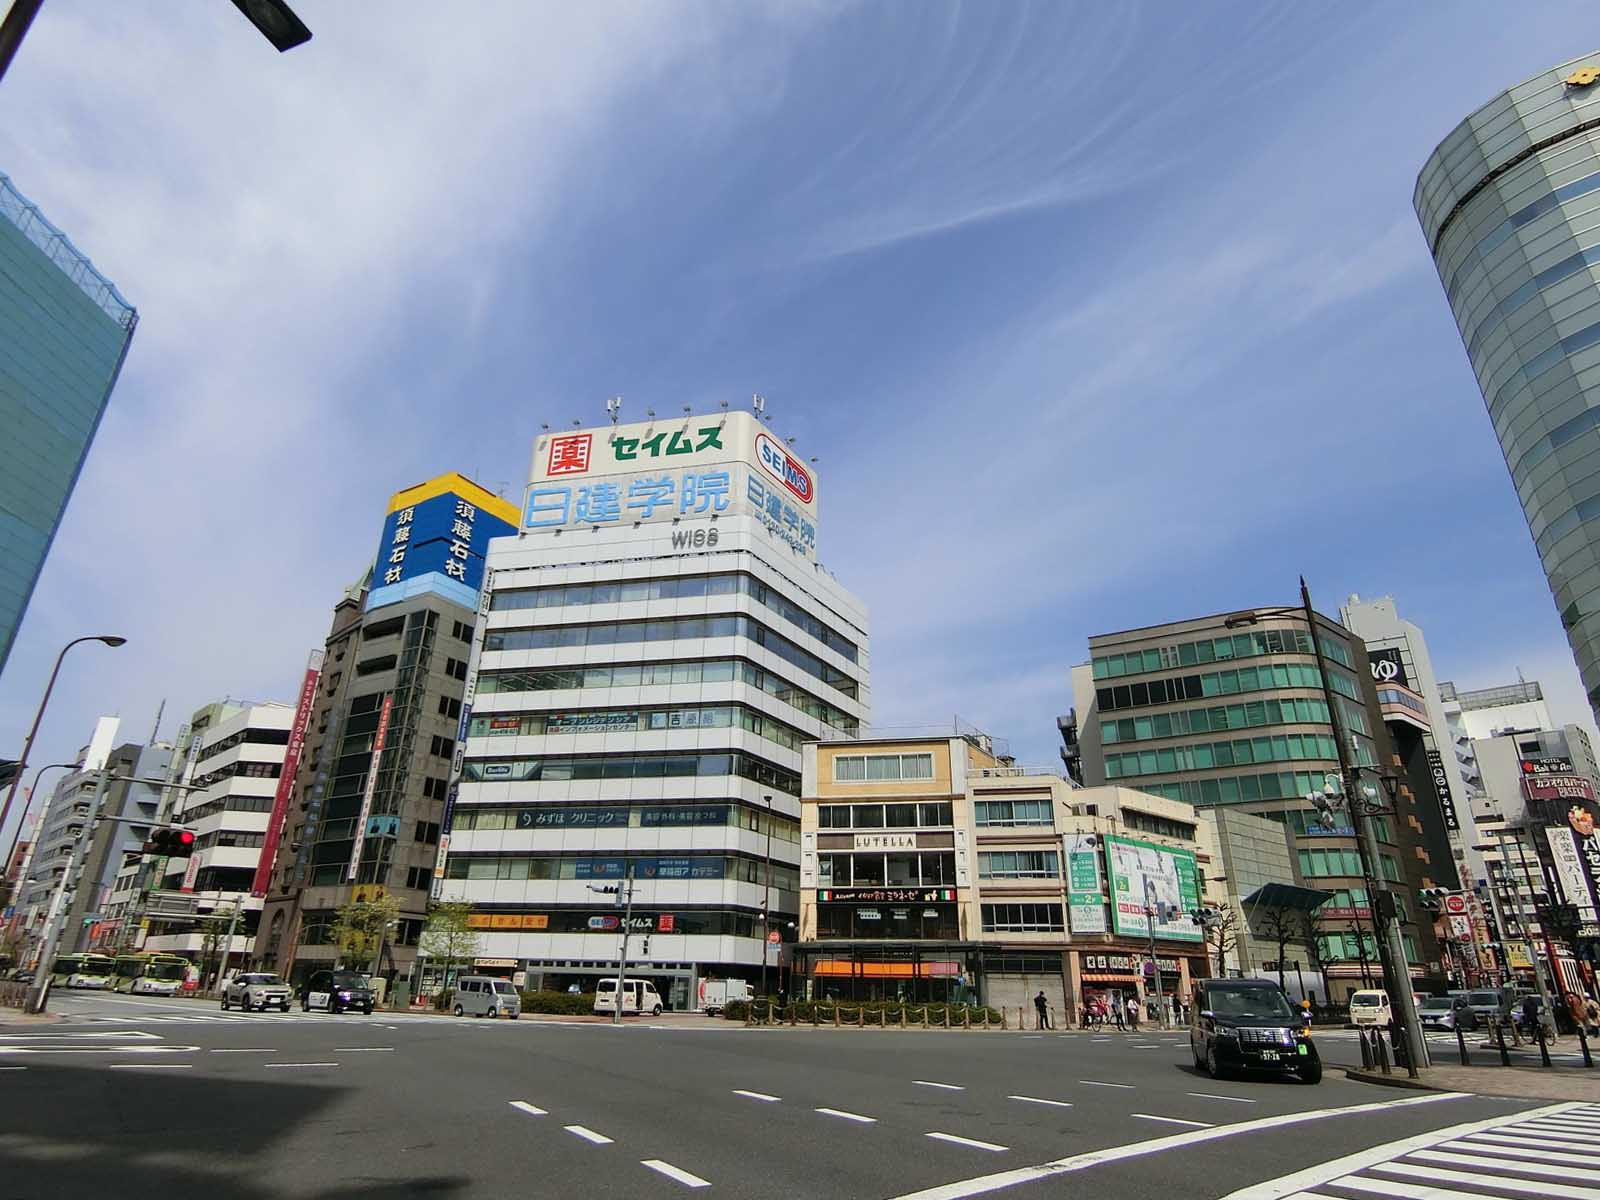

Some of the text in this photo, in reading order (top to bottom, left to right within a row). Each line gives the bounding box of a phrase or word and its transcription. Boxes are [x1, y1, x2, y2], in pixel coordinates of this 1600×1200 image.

[550, 436, 588, 472] 薬
[611, 427, 723, 461] セイムス
[762, 443, 807, 494] SEIMS
[525, 471, 730, 529] 日建学院
[748, 474, 816, 549] 日建学院
[384, 506, 415, 585] 須藤石材
[445, 501, 476, 582] 須藤石材
[536, 812, 615, 824] みずほ クリニック
[857, 837, 913, 847] LUTELLA
